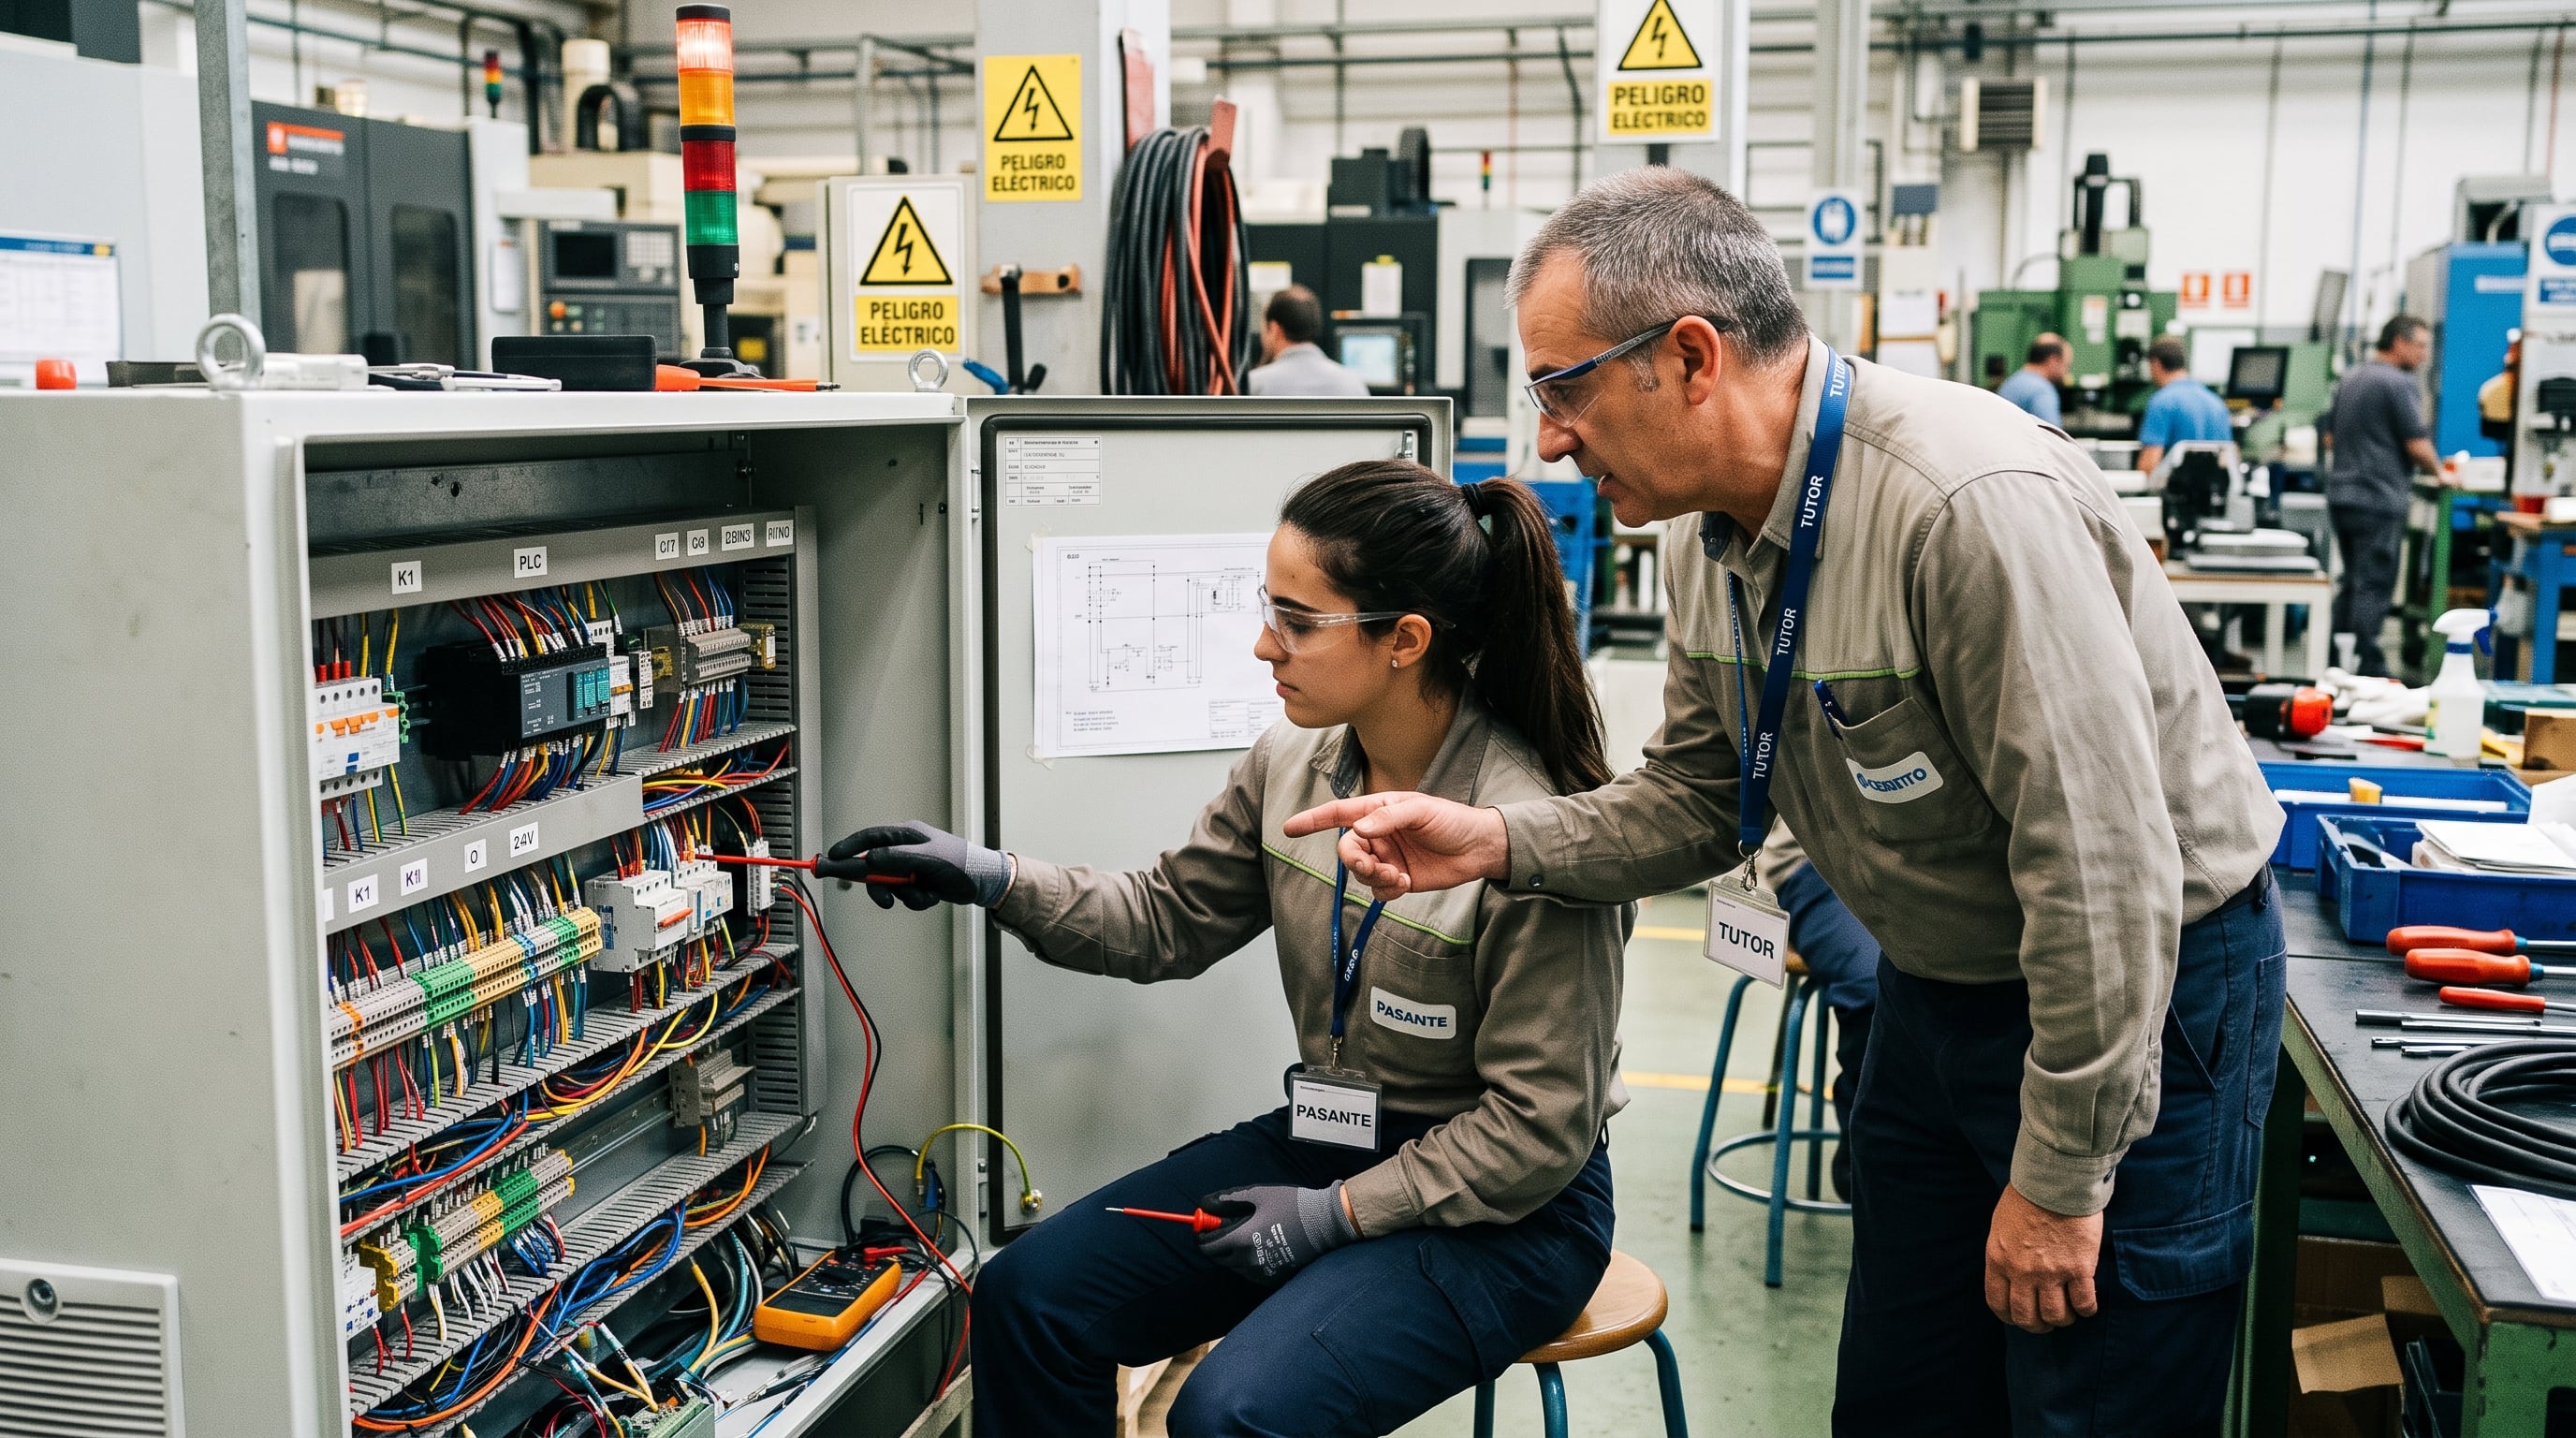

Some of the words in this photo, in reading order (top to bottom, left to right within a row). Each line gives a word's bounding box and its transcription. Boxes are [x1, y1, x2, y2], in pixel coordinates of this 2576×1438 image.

[1614, 84, 1705, 106] PELIGRO
[1001, 154, 1066, 170] PELIGRO
[870, 301, 944, 320] PELIGRO
[860, 321, 955, 345] ELÉCTRICO
[1800, 475, 1824, 528] TUTOR
[520, 554, 542, 571] PLC
[398, 569, 414, 587] K1
[1776, 608, 1796, 655] TUTOR
[1752, 731, 1774, 779] TUTOR
[355, 885, 370, 904] K1
[1719, 920, 1775, 960] TUTOR
[1377, 1000, 1448, 1028] PASANTE
[1296, 1104, 1372, 1128] PASANTE
